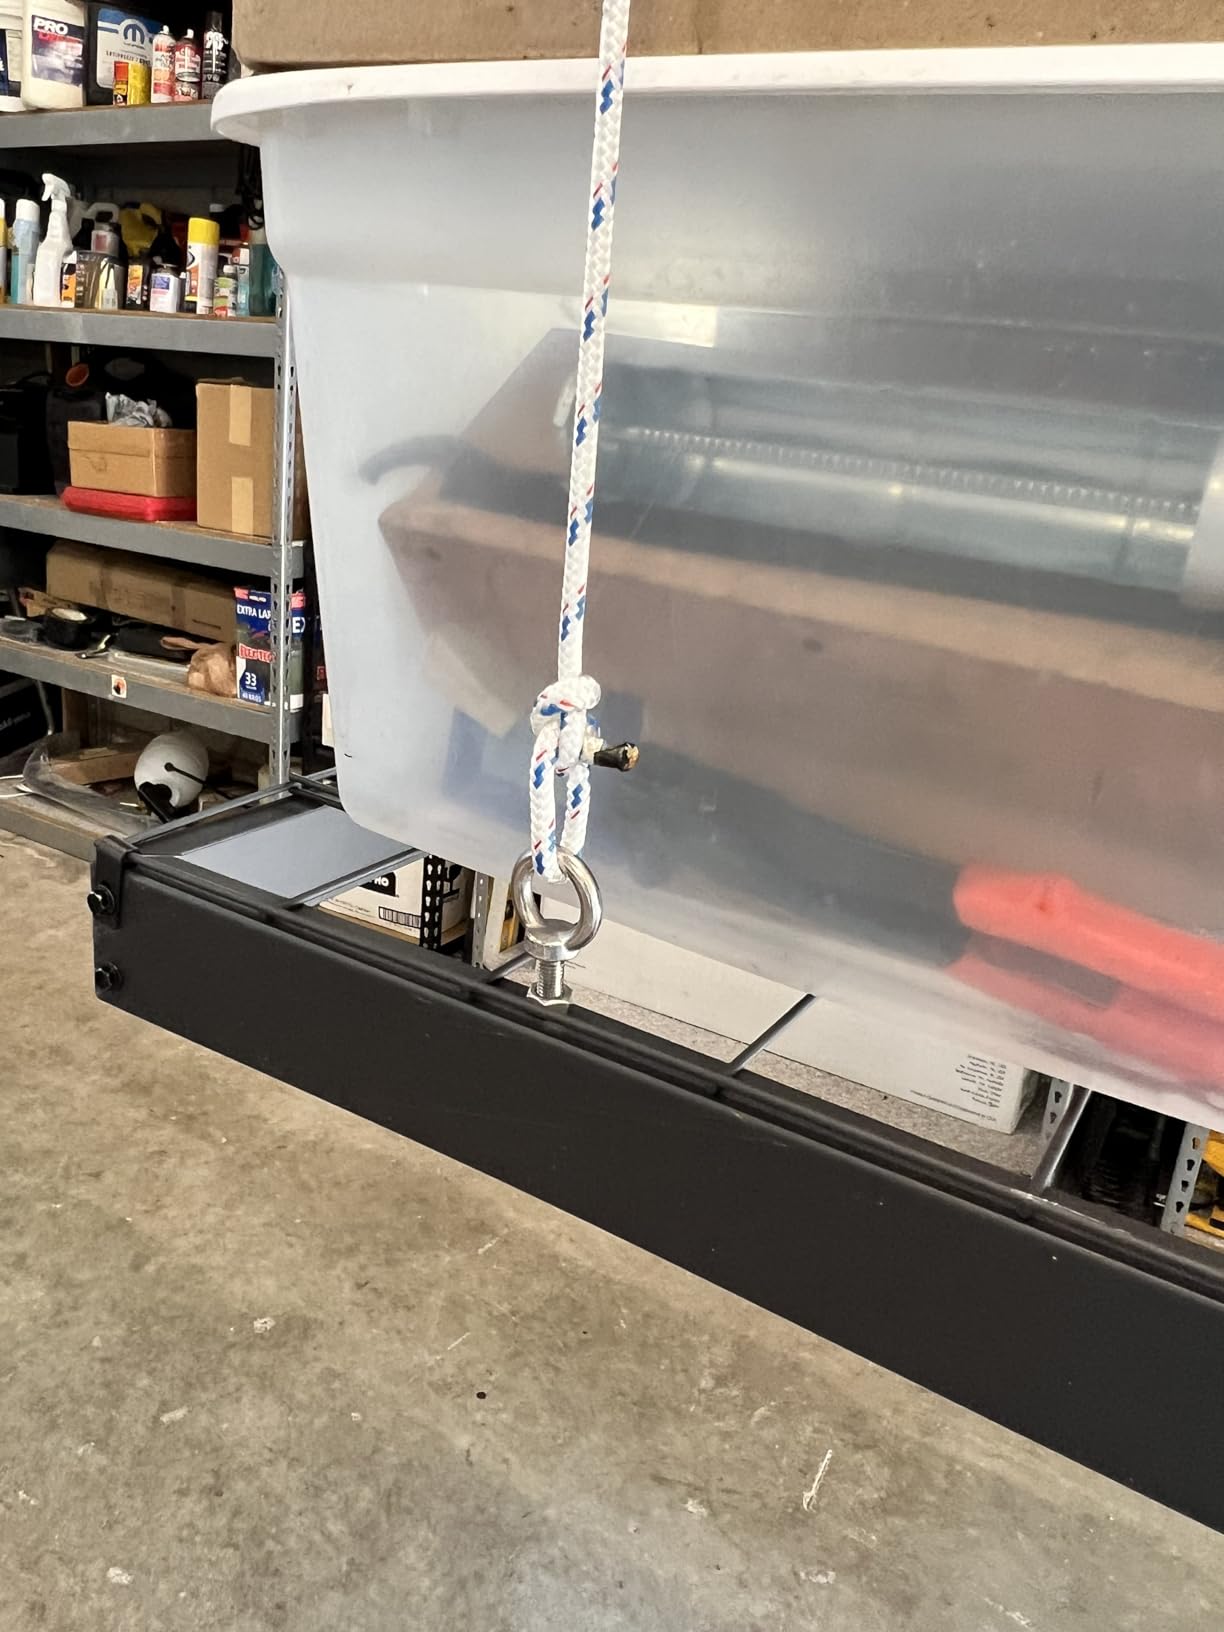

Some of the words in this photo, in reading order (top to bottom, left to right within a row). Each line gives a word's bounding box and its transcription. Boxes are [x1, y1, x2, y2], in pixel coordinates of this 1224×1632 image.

[33, 17, 69, 36] PRO
[236, 603, 257, 617] EXTRA
[245, 671, 257, 687] 33
